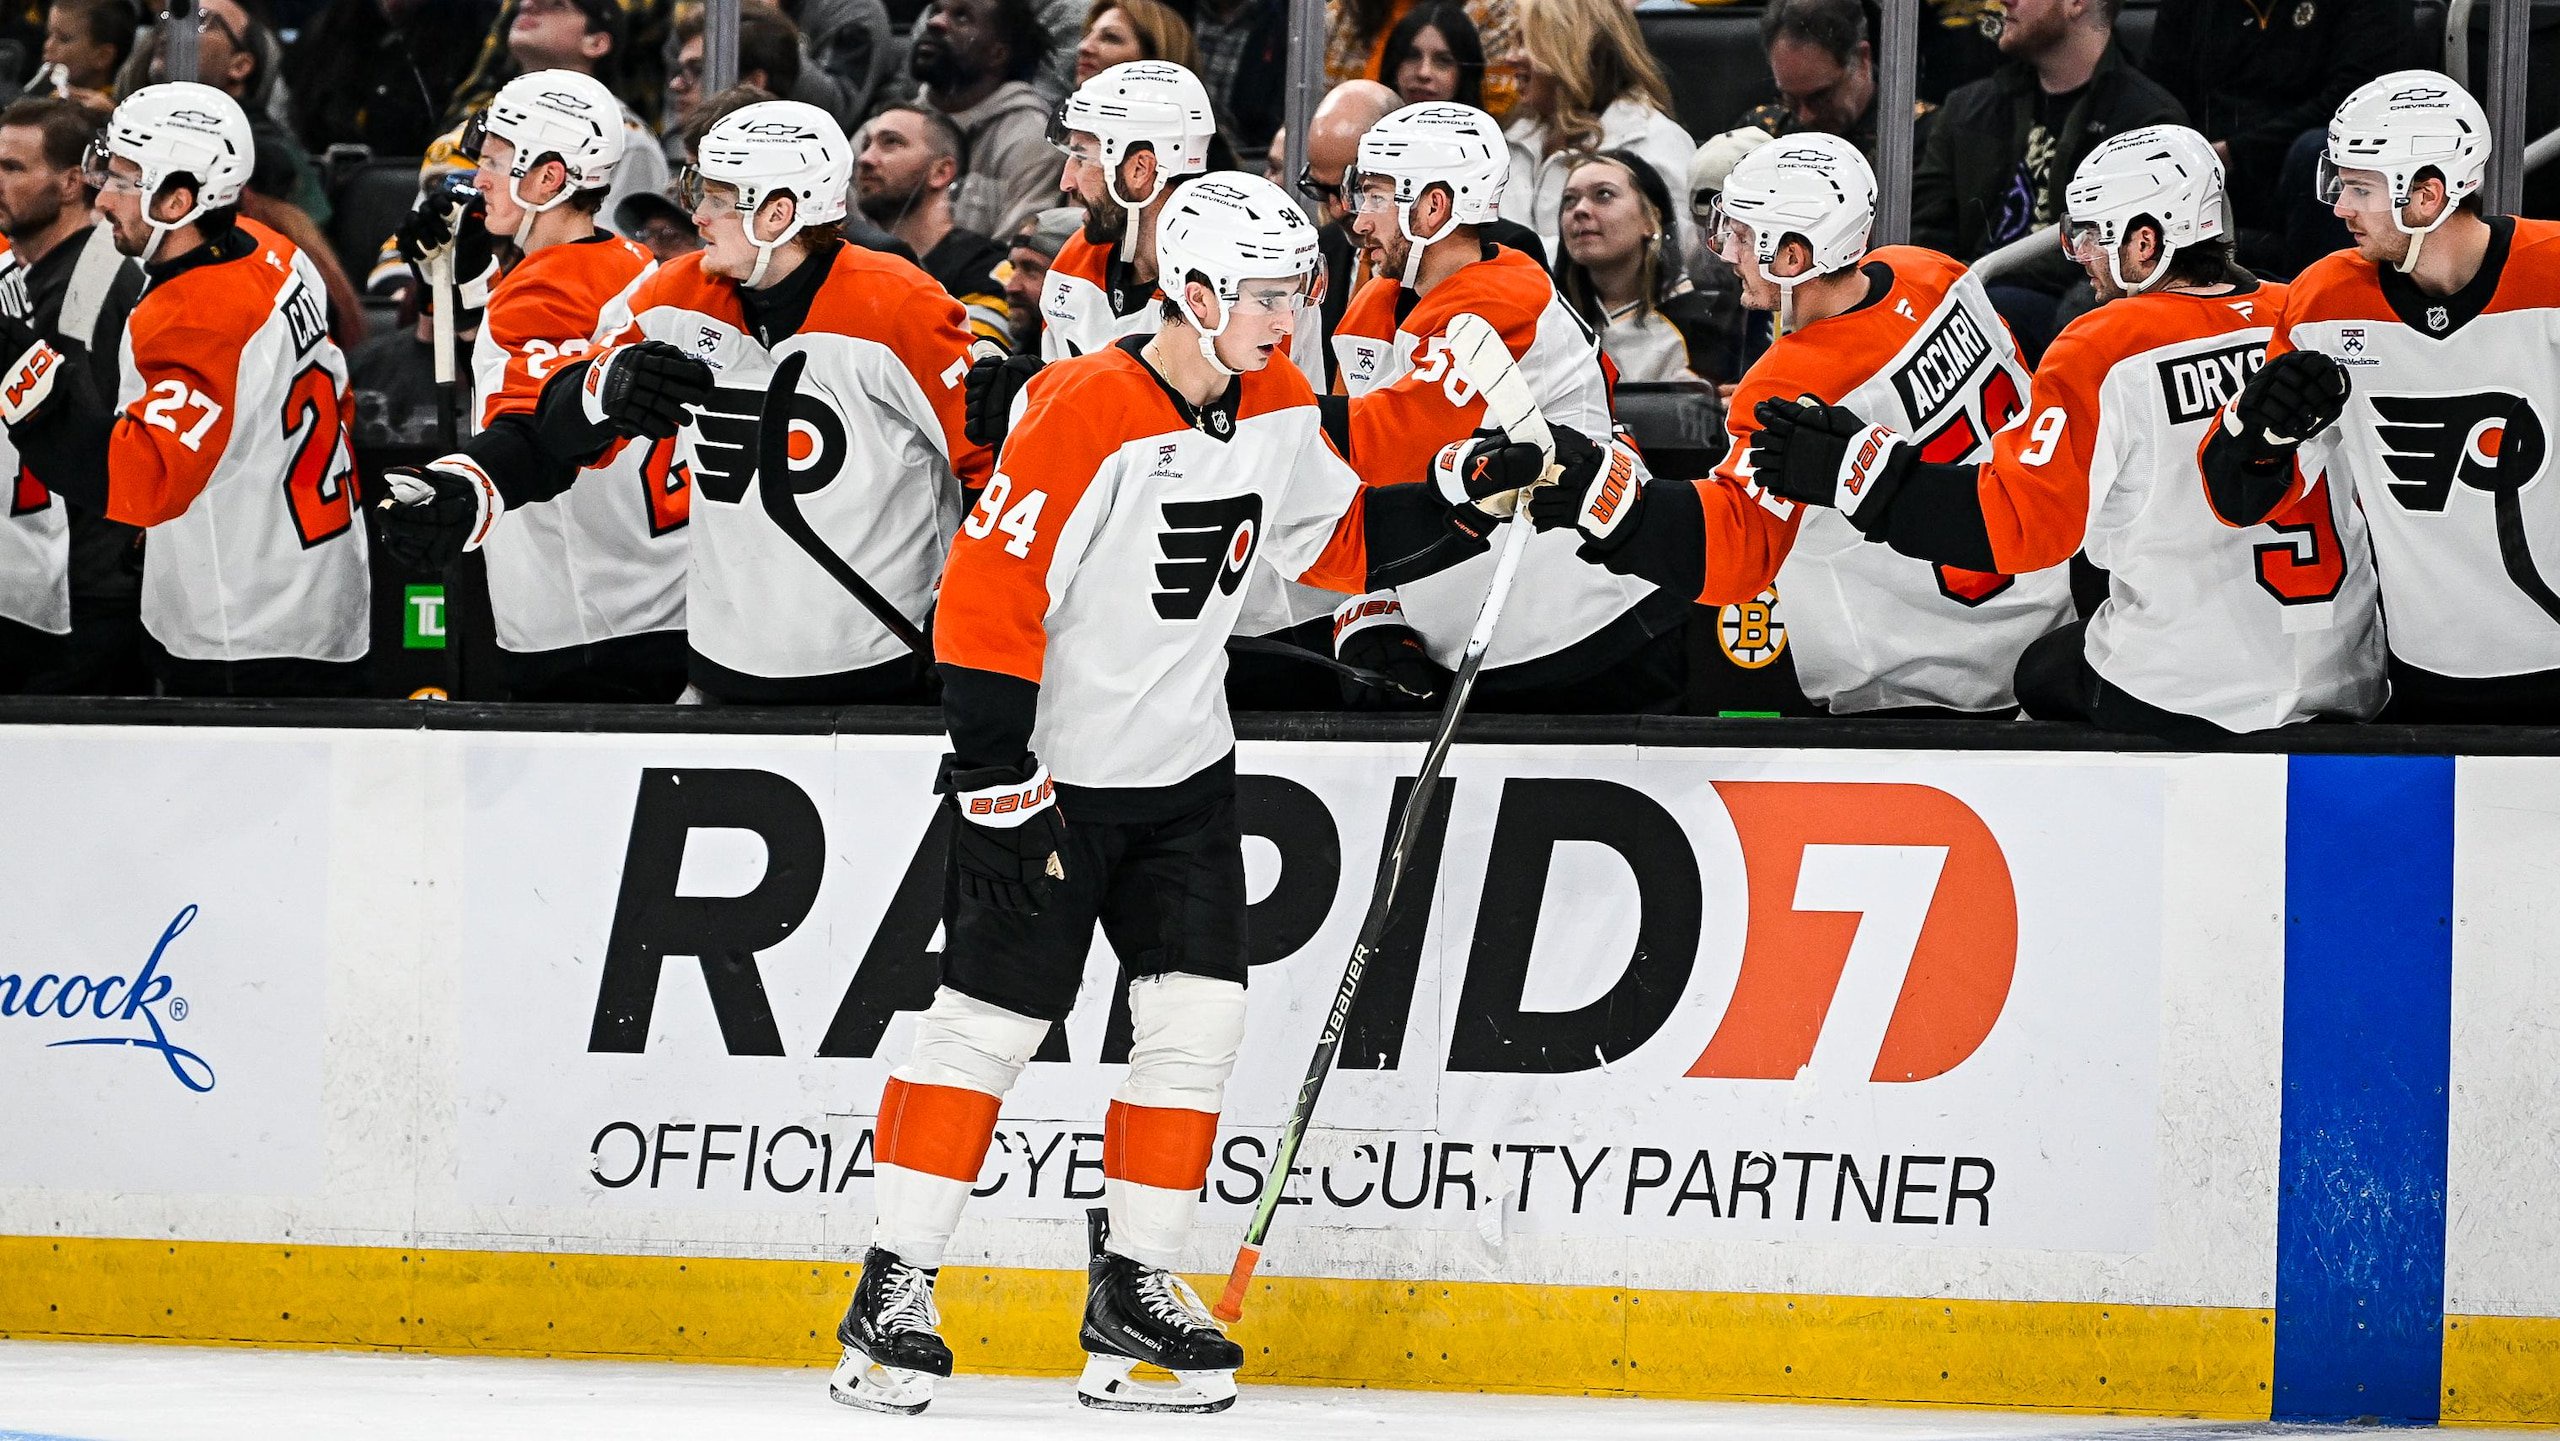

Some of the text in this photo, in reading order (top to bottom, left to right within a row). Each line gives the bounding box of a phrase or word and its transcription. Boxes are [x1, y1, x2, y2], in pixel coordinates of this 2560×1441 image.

[1121, 76, 1179, 84] CHEVROLET
[1777, 163, 1836, 171] CHEVROLET
[1190, 192, 1244, 210] CHEVROLET
[1907, 308, 1986, 419] ACCIARI
[143, 379, 223, 452] 27
[2019, 406, 2068, 467] 9
[963, 471, 1049, 560] 94
[1738, 602, 1772, 649] B
[1329, 943, 1370, 1032] BAUER
[1623, 1147, 1996, 1227] PARTNER
[1122, 1325, 1163, 1352] BAUER
